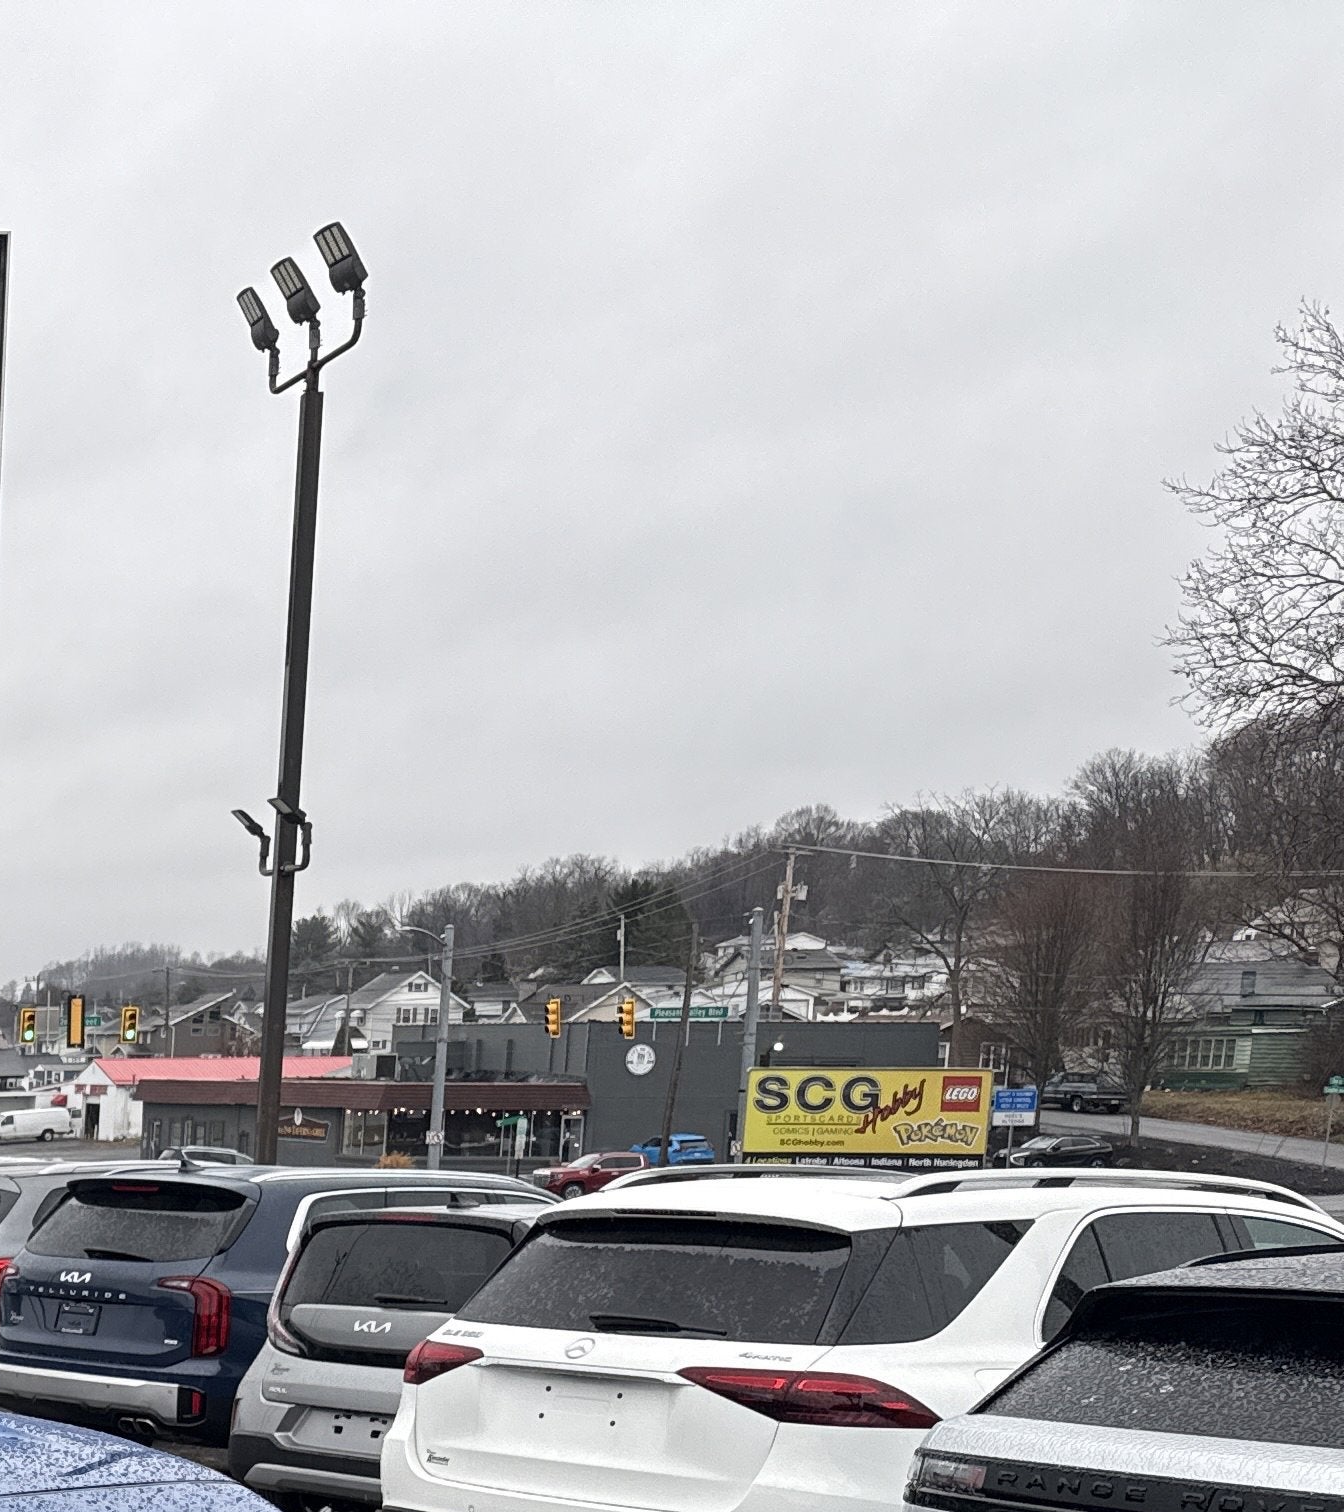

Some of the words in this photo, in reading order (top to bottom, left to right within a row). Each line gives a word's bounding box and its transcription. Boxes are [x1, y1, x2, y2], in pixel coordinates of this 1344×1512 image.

[655, 1006, 682, 1017] Pleasan
[689, 1006, 706, 1018] alley
[708, 1006, 724, 1016] Blvd
[753, 1073, 883, 1115] SCG
[943, 1085, 980, 1102] LEGO
[854, 1078, 926, 1135] Hobby
[772, 1127, 809, 1136] COMICS
[816, 1127, 854, 1136] GAMING
[29, 1285, 127, 1300] TELLURIDE
[997, 1470, 1148, 1503] RANGE
